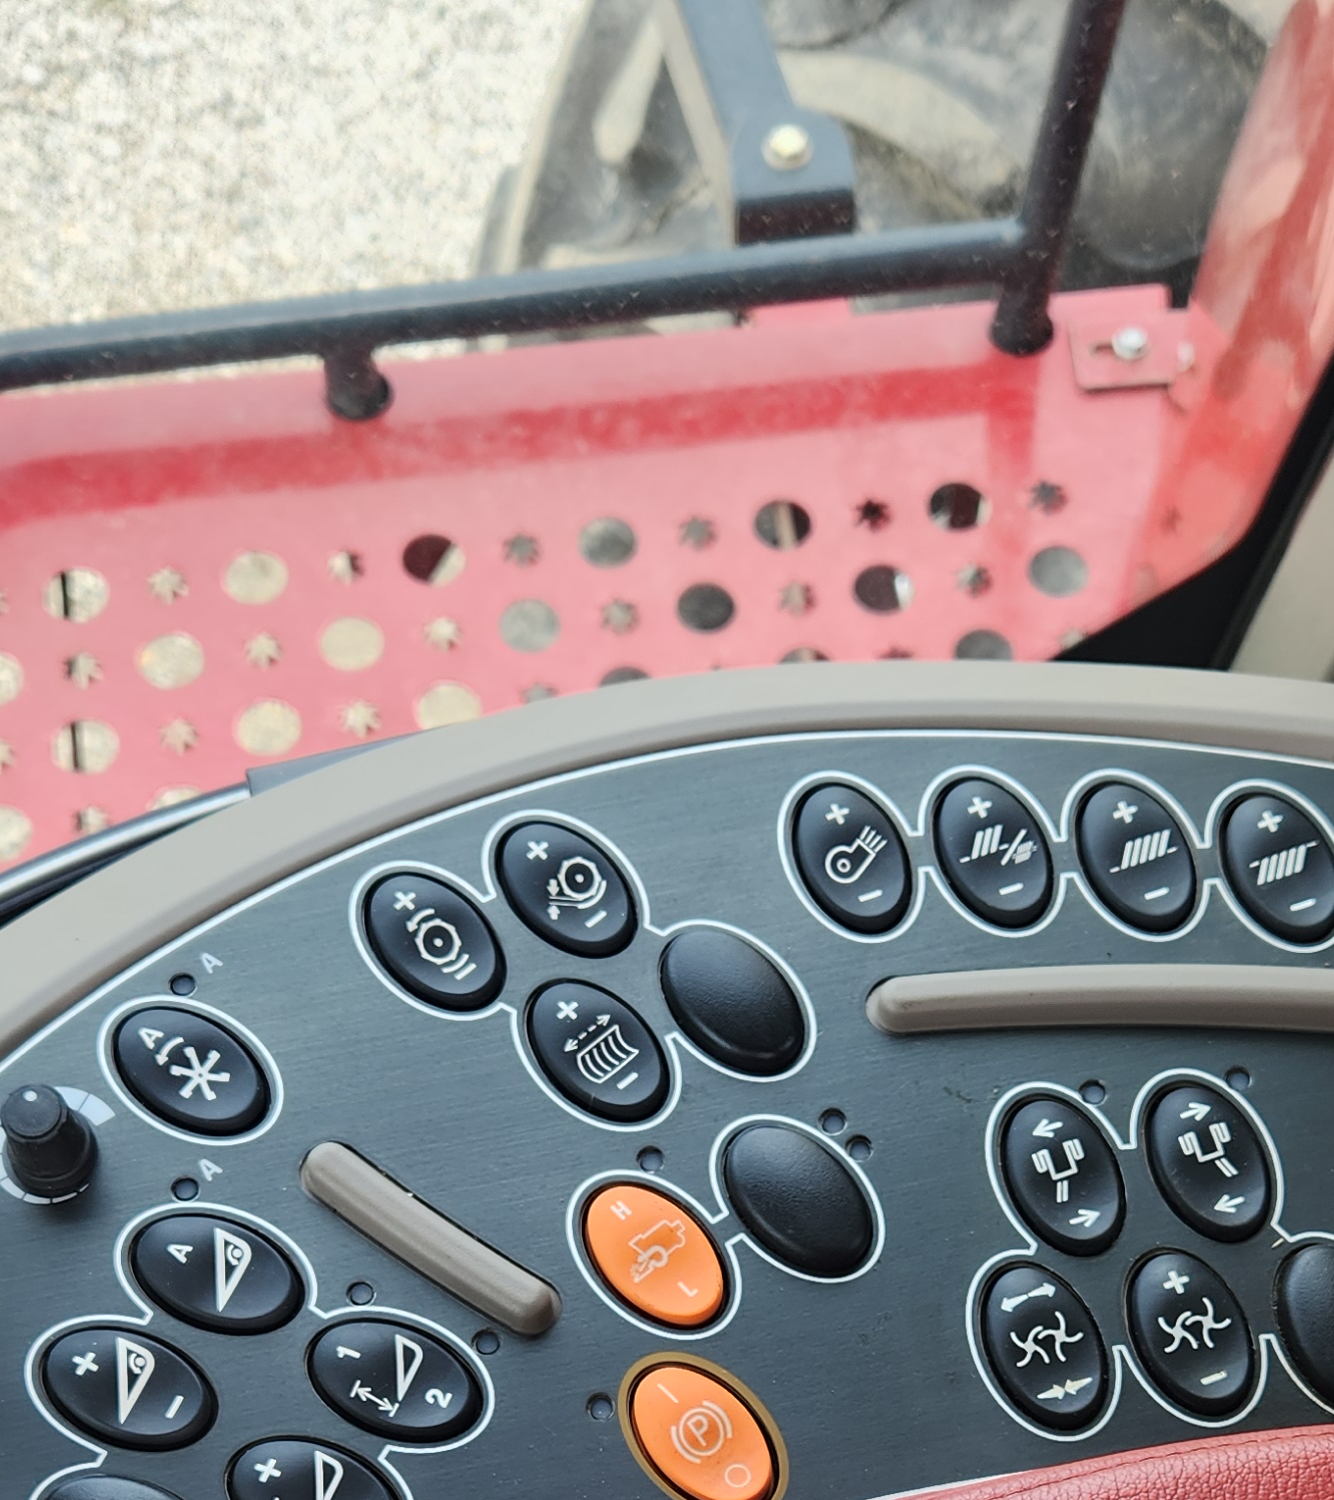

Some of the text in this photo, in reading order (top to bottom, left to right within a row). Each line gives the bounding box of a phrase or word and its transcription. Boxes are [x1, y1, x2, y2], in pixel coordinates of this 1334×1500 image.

[201, 952, 223, 973] A
[138, 1027, 164, 1049] A
[199, 1158, 223, 1180] A
[610, 1200, 632, 1221] H
[167, 1243, 193, 1264] A
[677, 1281, 699, 1298] L
[425, 1388, 452, 1408] 2
[687, 1415, 708, 1447] P
